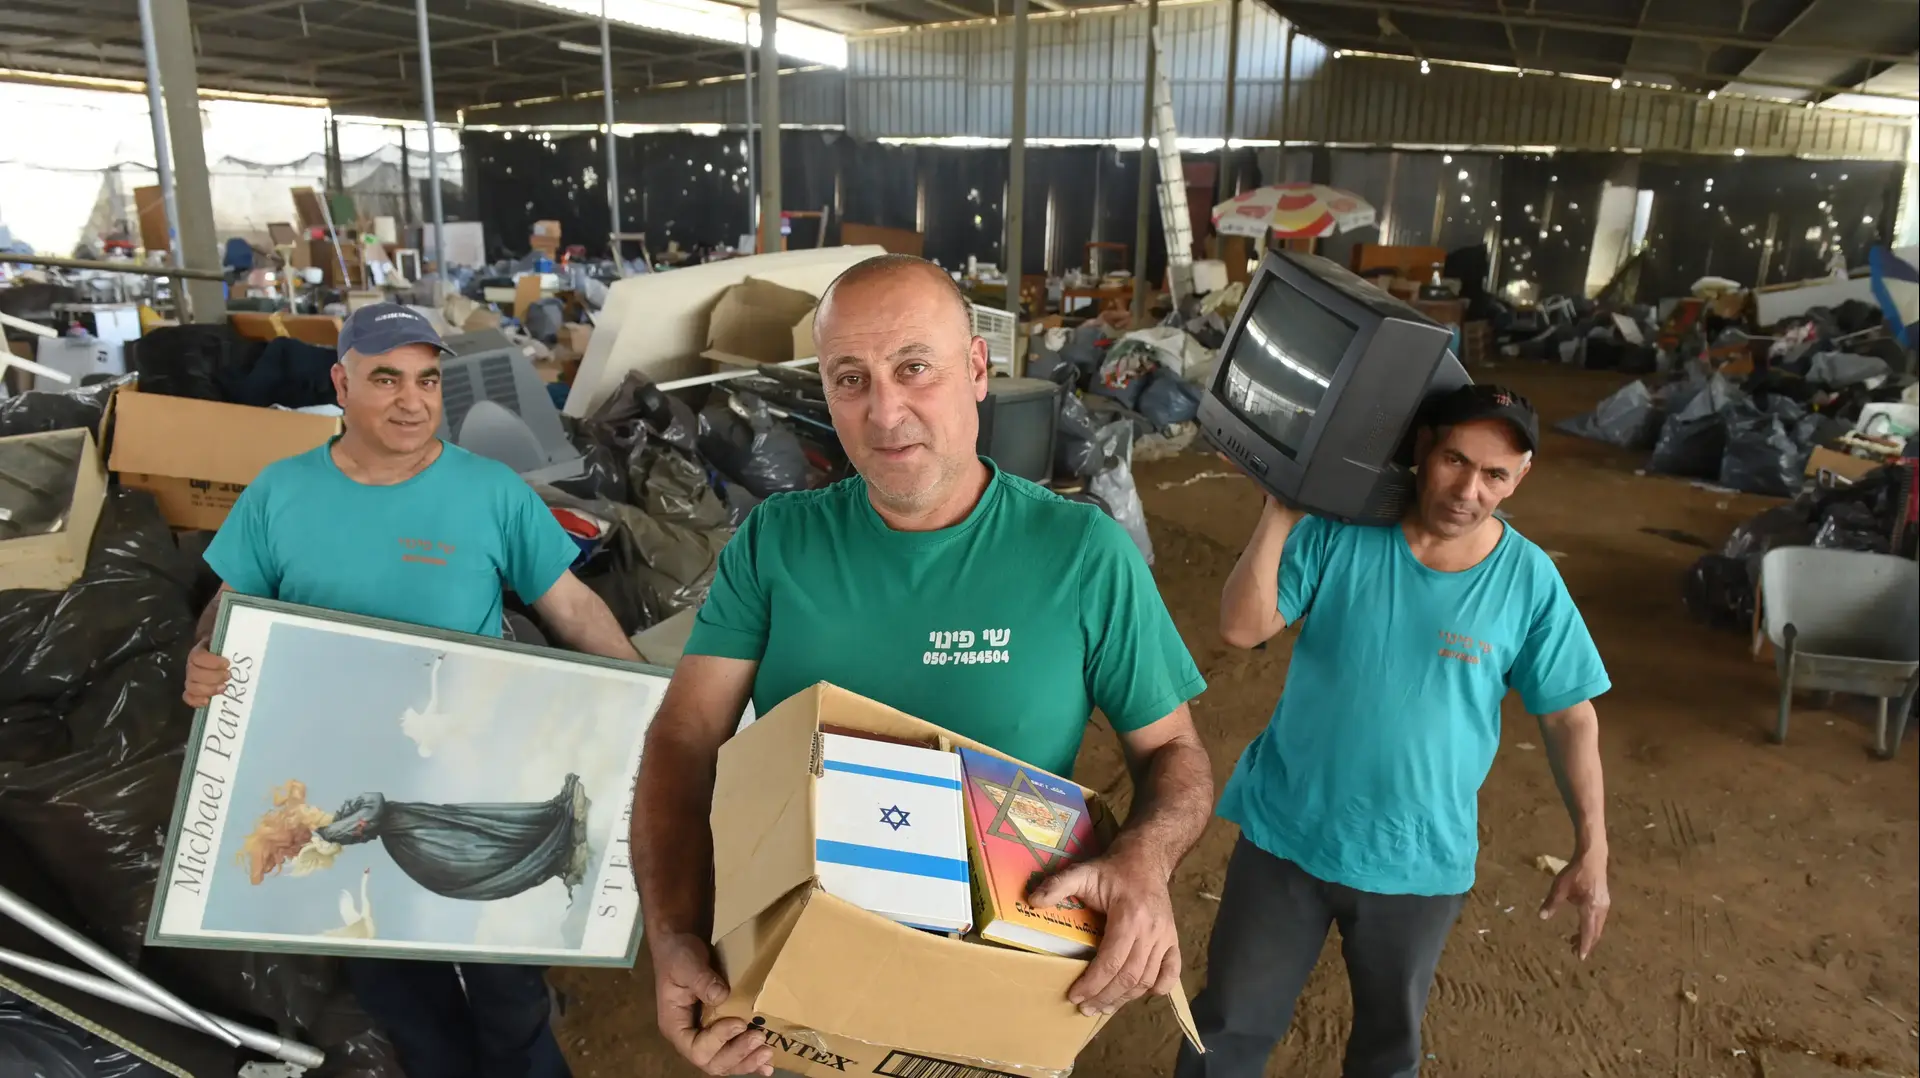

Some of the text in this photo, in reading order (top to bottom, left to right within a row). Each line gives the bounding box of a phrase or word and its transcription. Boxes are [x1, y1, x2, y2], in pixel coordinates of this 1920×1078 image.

[929, 628, 1011, 649] שי פינוי
[922, 650, 1010, 666] 050-7454504
[173, 652, 253, 896] Michael Parkes
[747, 1022, 851, 1072] INTEX
